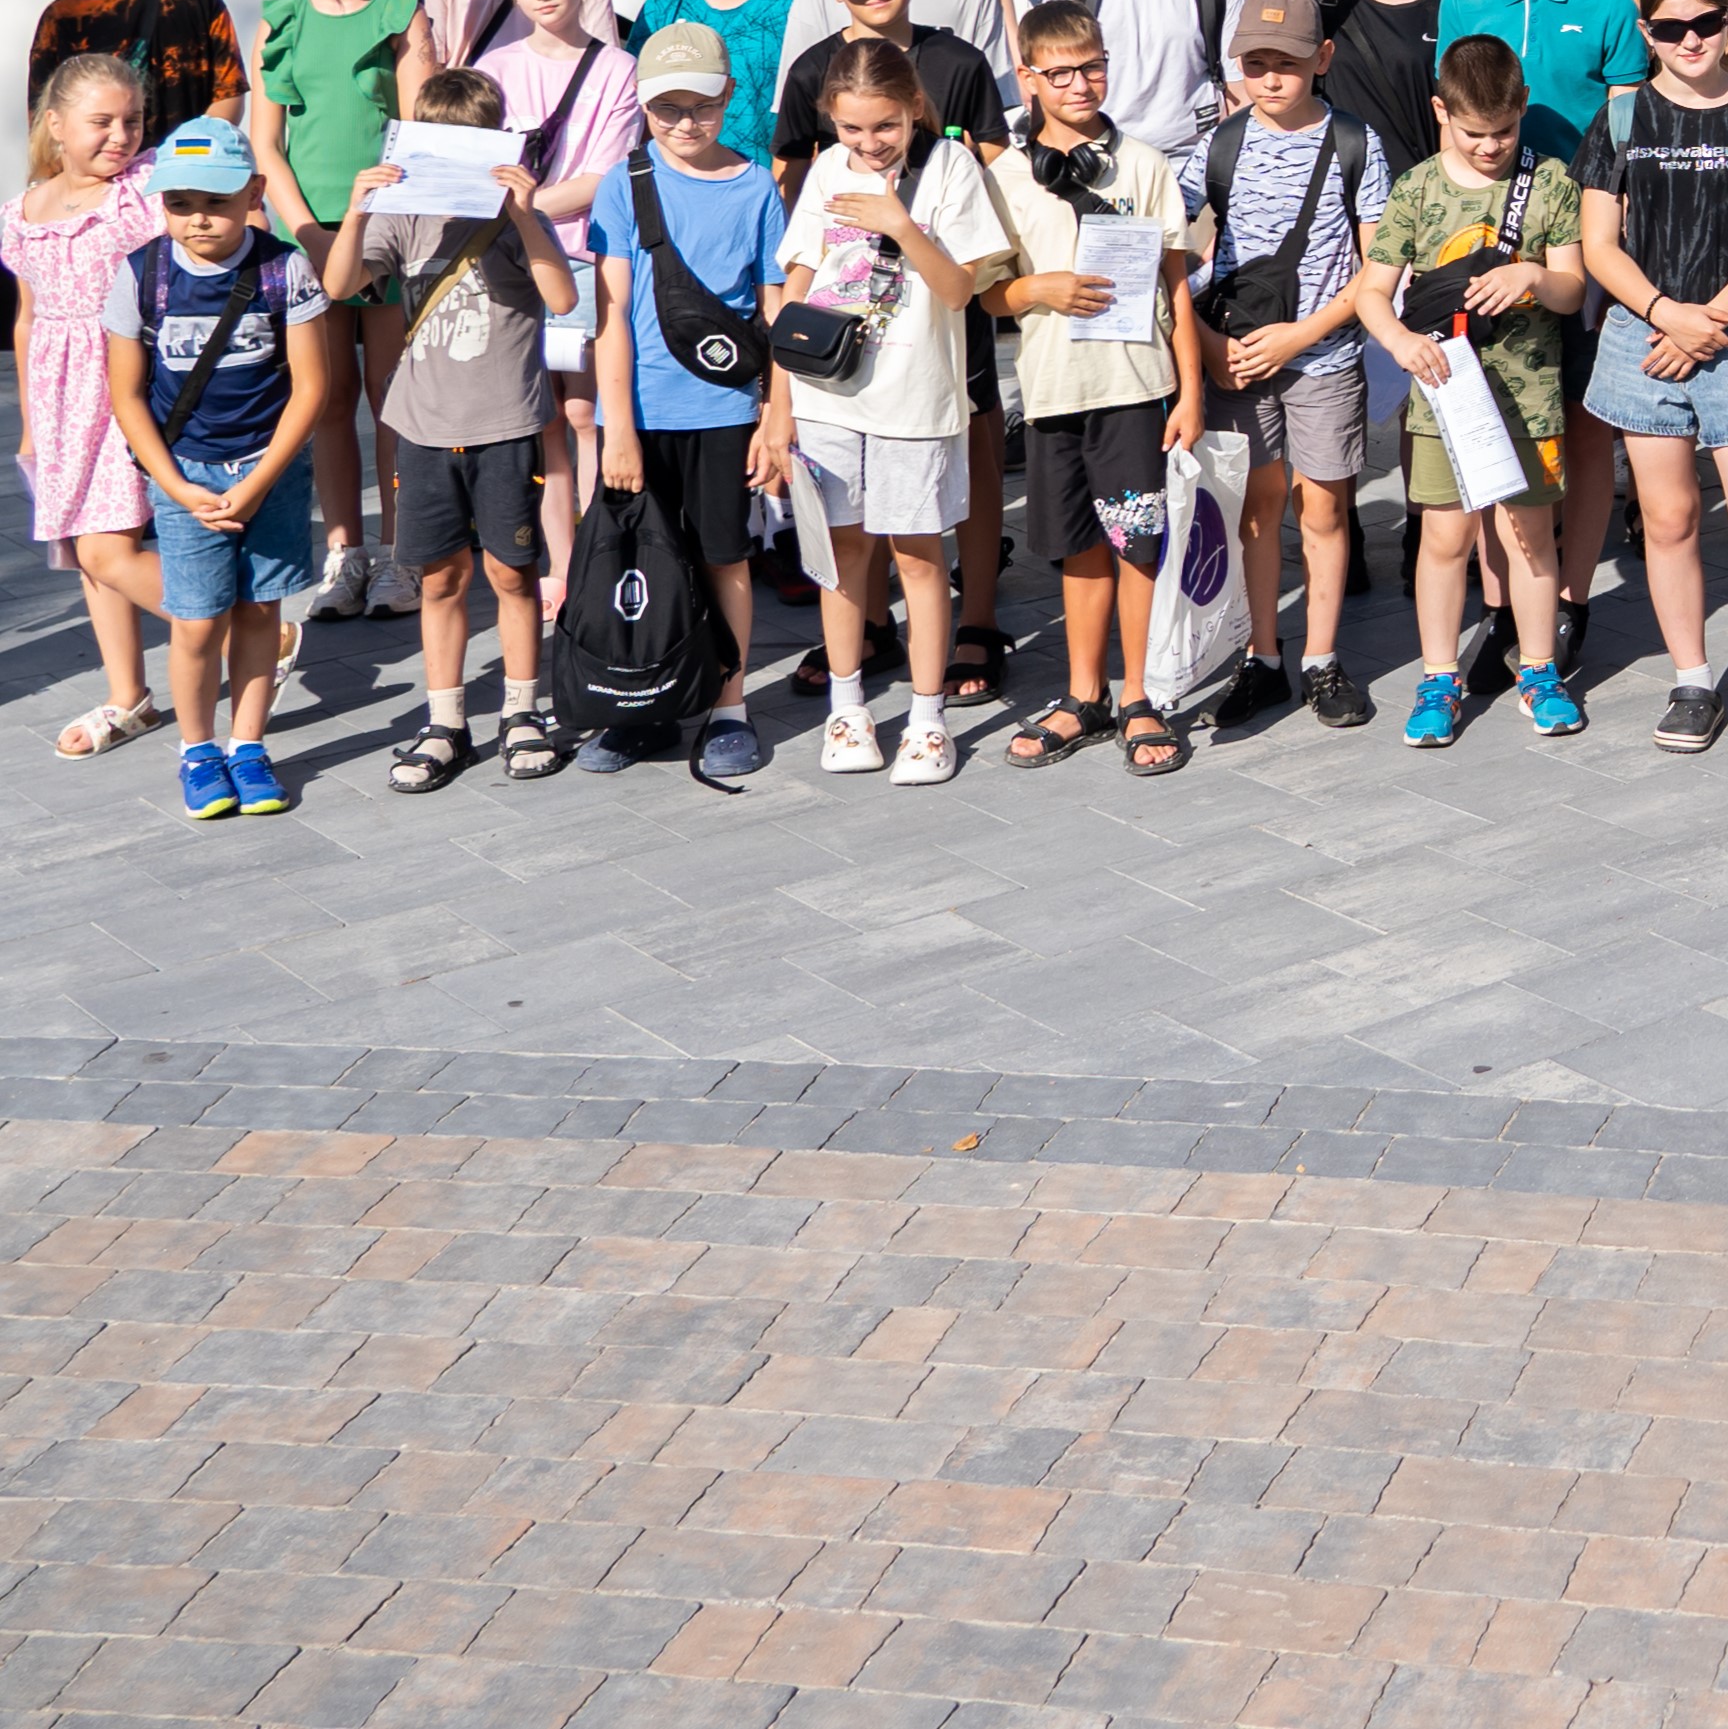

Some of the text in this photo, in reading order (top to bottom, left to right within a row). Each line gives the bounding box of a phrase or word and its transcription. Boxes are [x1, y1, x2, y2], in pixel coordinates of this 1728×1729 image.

[1659, 160, 1692, 170] new
[421, 315, 455, 348] BOY
[629, 687, 660, 697] MARTIAL
[616, 698, 656, 708] ACADEMY
